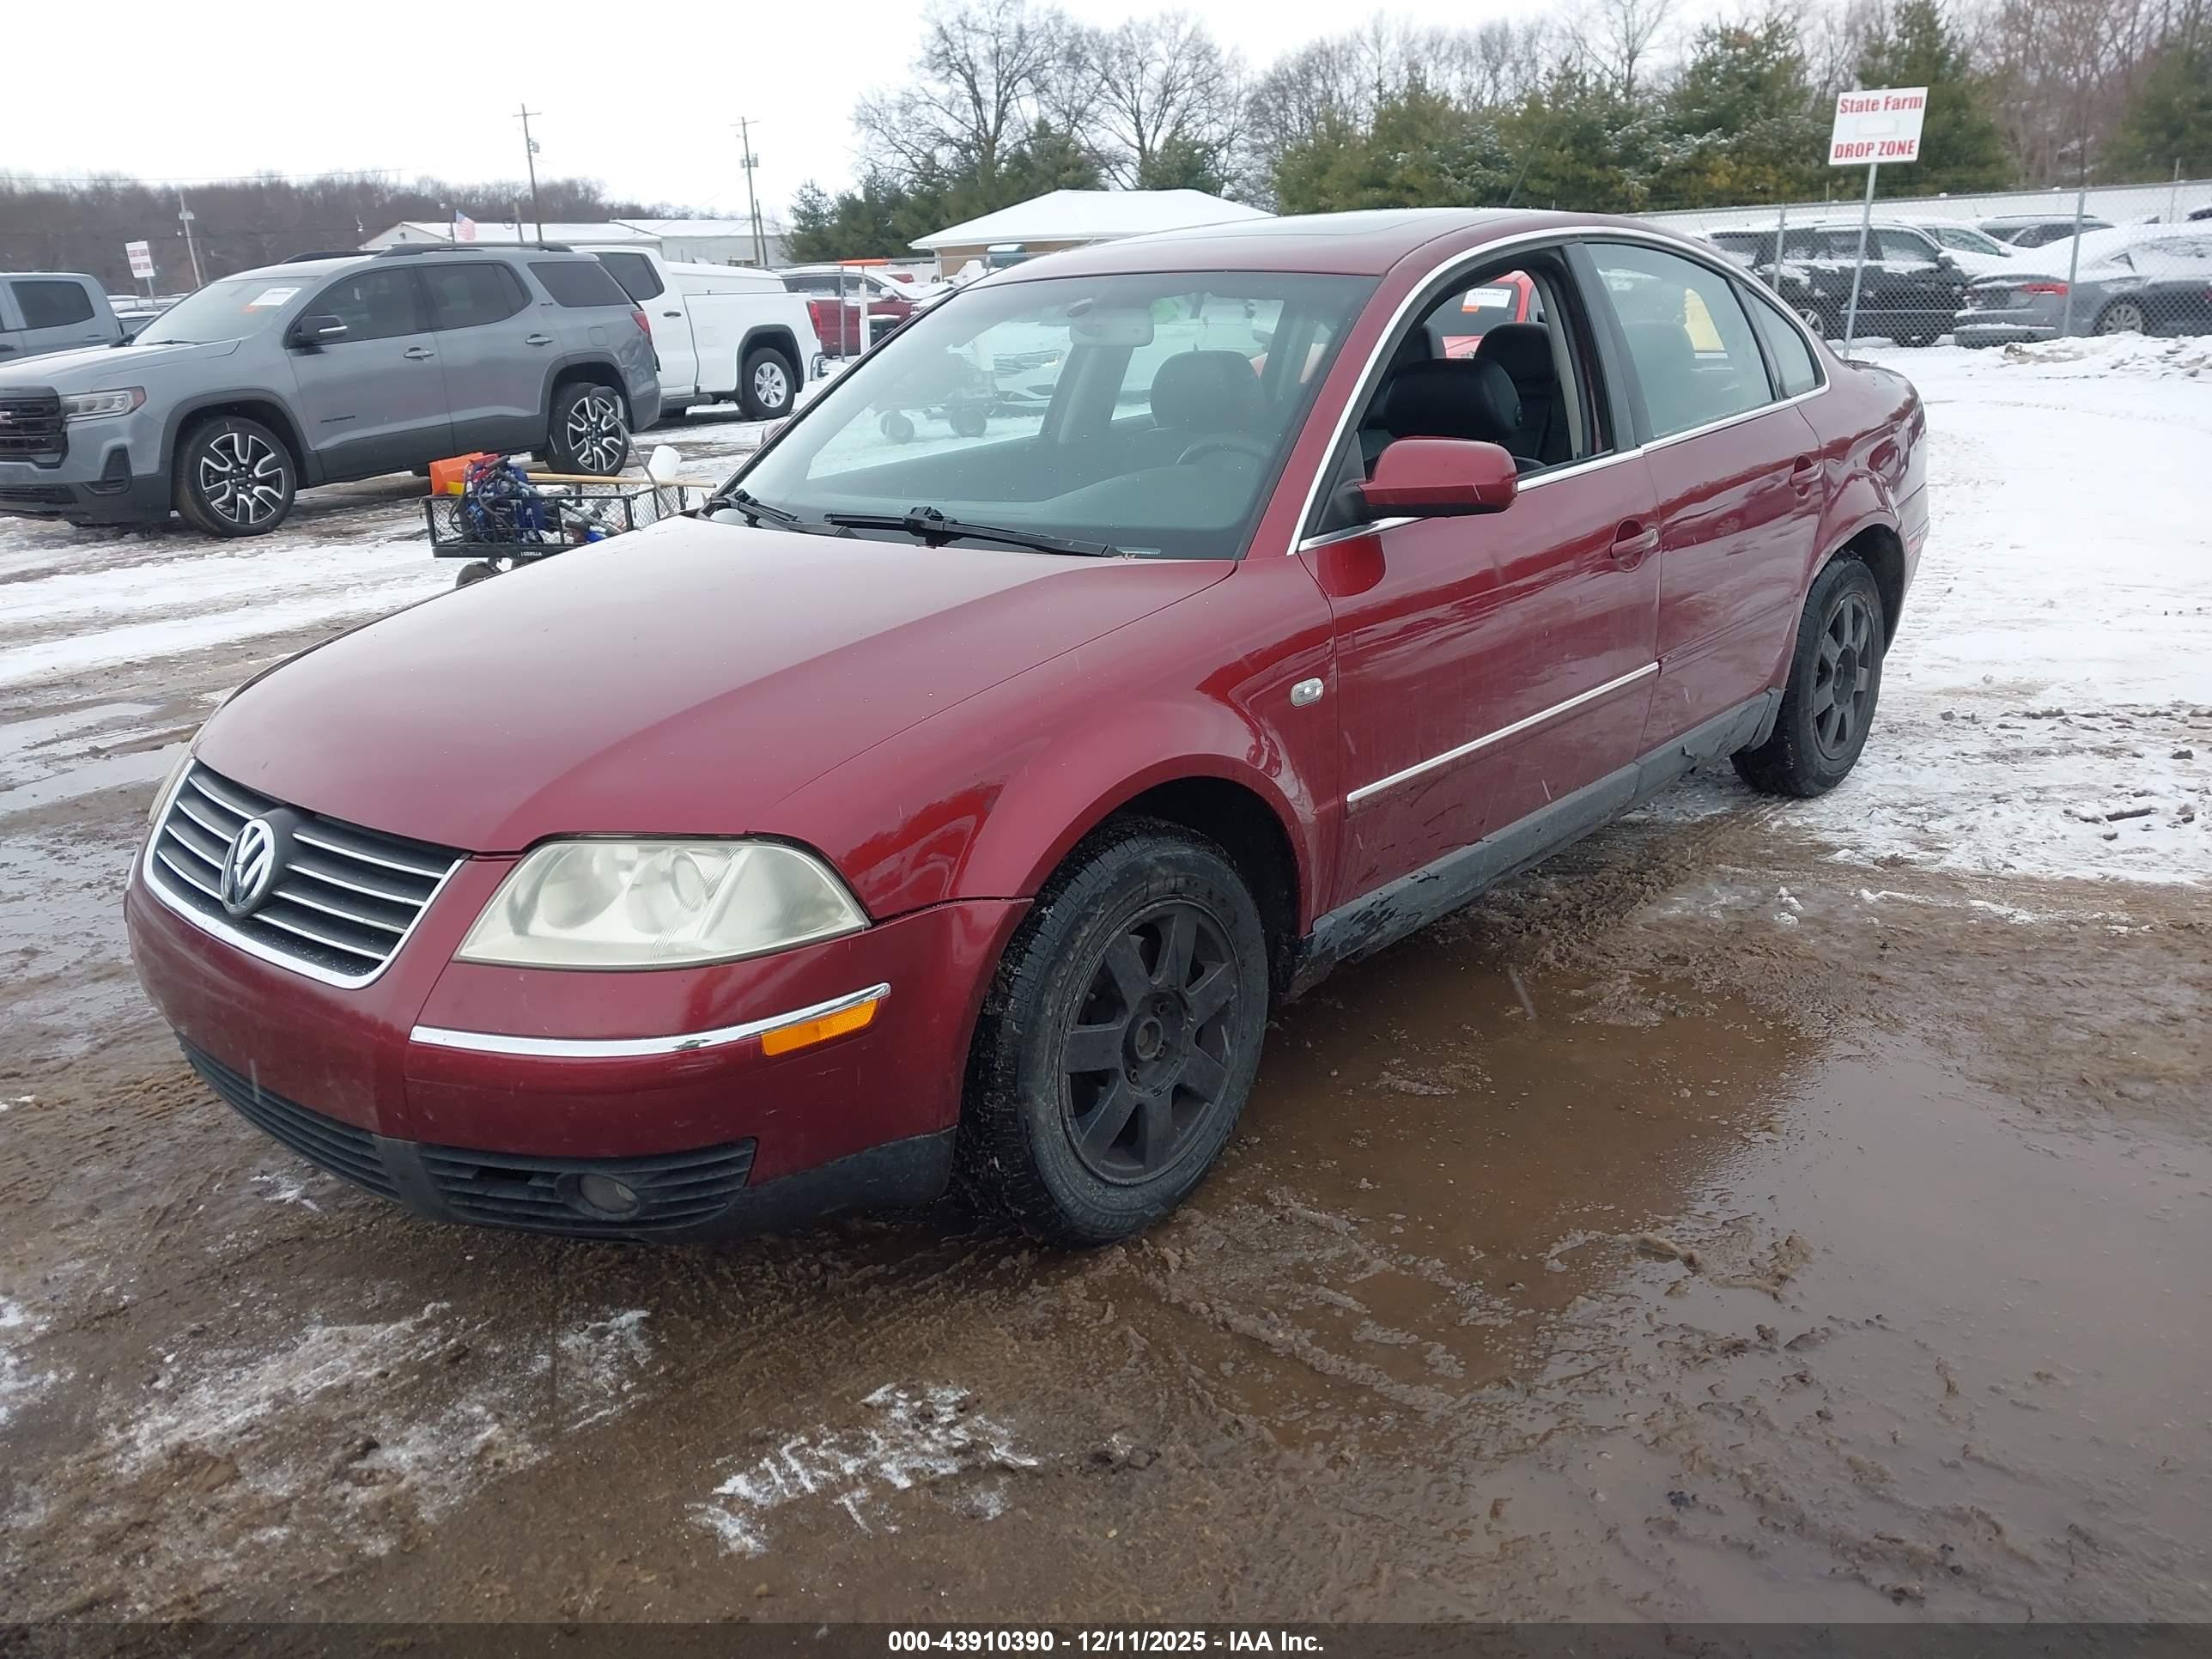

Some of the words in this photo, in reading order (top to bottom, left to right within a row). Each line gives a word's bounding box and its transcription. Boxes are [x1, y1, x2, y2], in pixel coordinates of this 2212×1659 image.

[1840, 98, 1880, 114] State
[1884, 95, 1923, 111] Farm
[1833, 143, 1875, 159] DROP
[1878, 140, 1916, 156] ZONE
